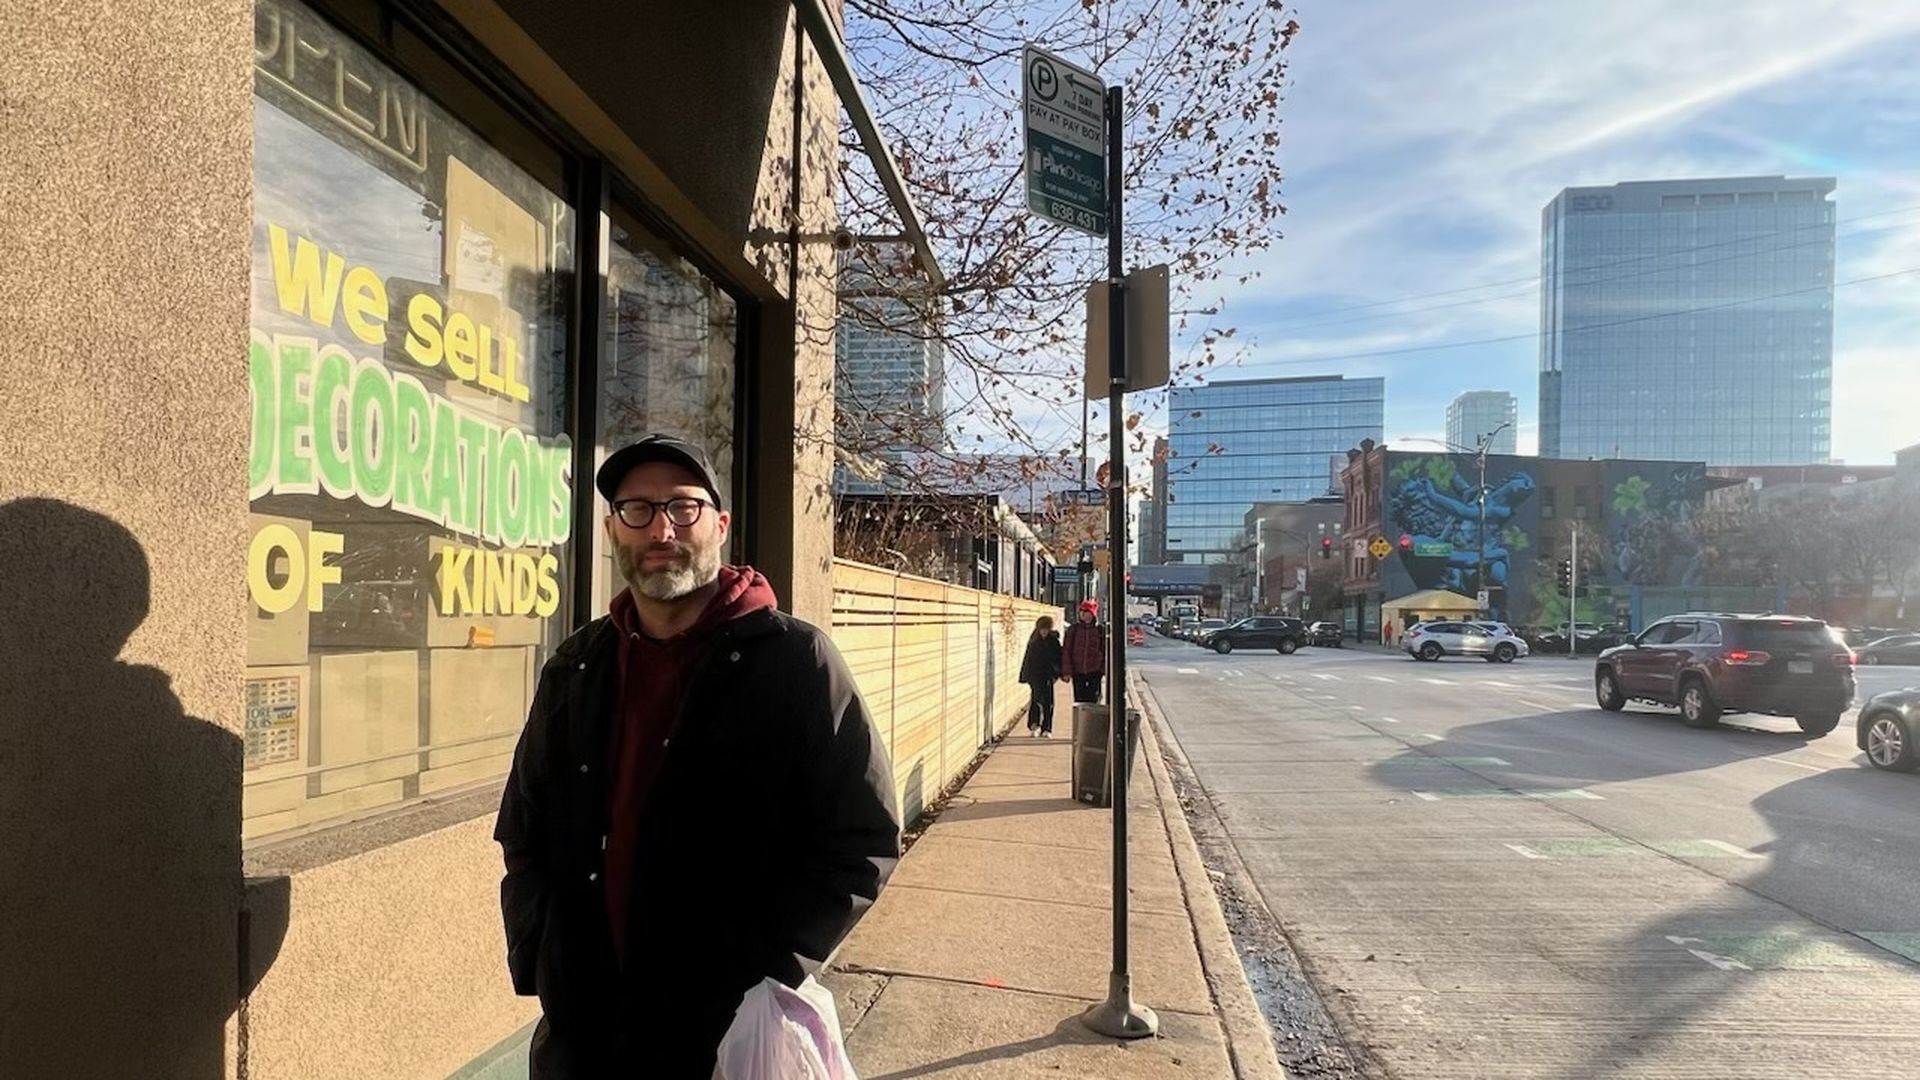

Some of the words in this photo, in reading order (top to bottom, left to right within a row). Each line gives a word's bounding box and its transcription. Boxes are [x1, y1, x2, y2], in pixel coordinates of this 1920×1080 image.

[1037, 65, 1052, 92] P
[1029, 104, 1047, 121] PAY
[1049, 111, 1061, 126] AT
[1063, 117, 1079, 133] PAY
[1082, 126, 1101, 143] BOX
[1051, 203, 1074, 222] 638
[1077, 211, 1097, 231] 431
[250, 329, 573, 549] DECORATIONS
[248, 523, 344, 614] OF
[441, 545, 560, 618] KINDS
